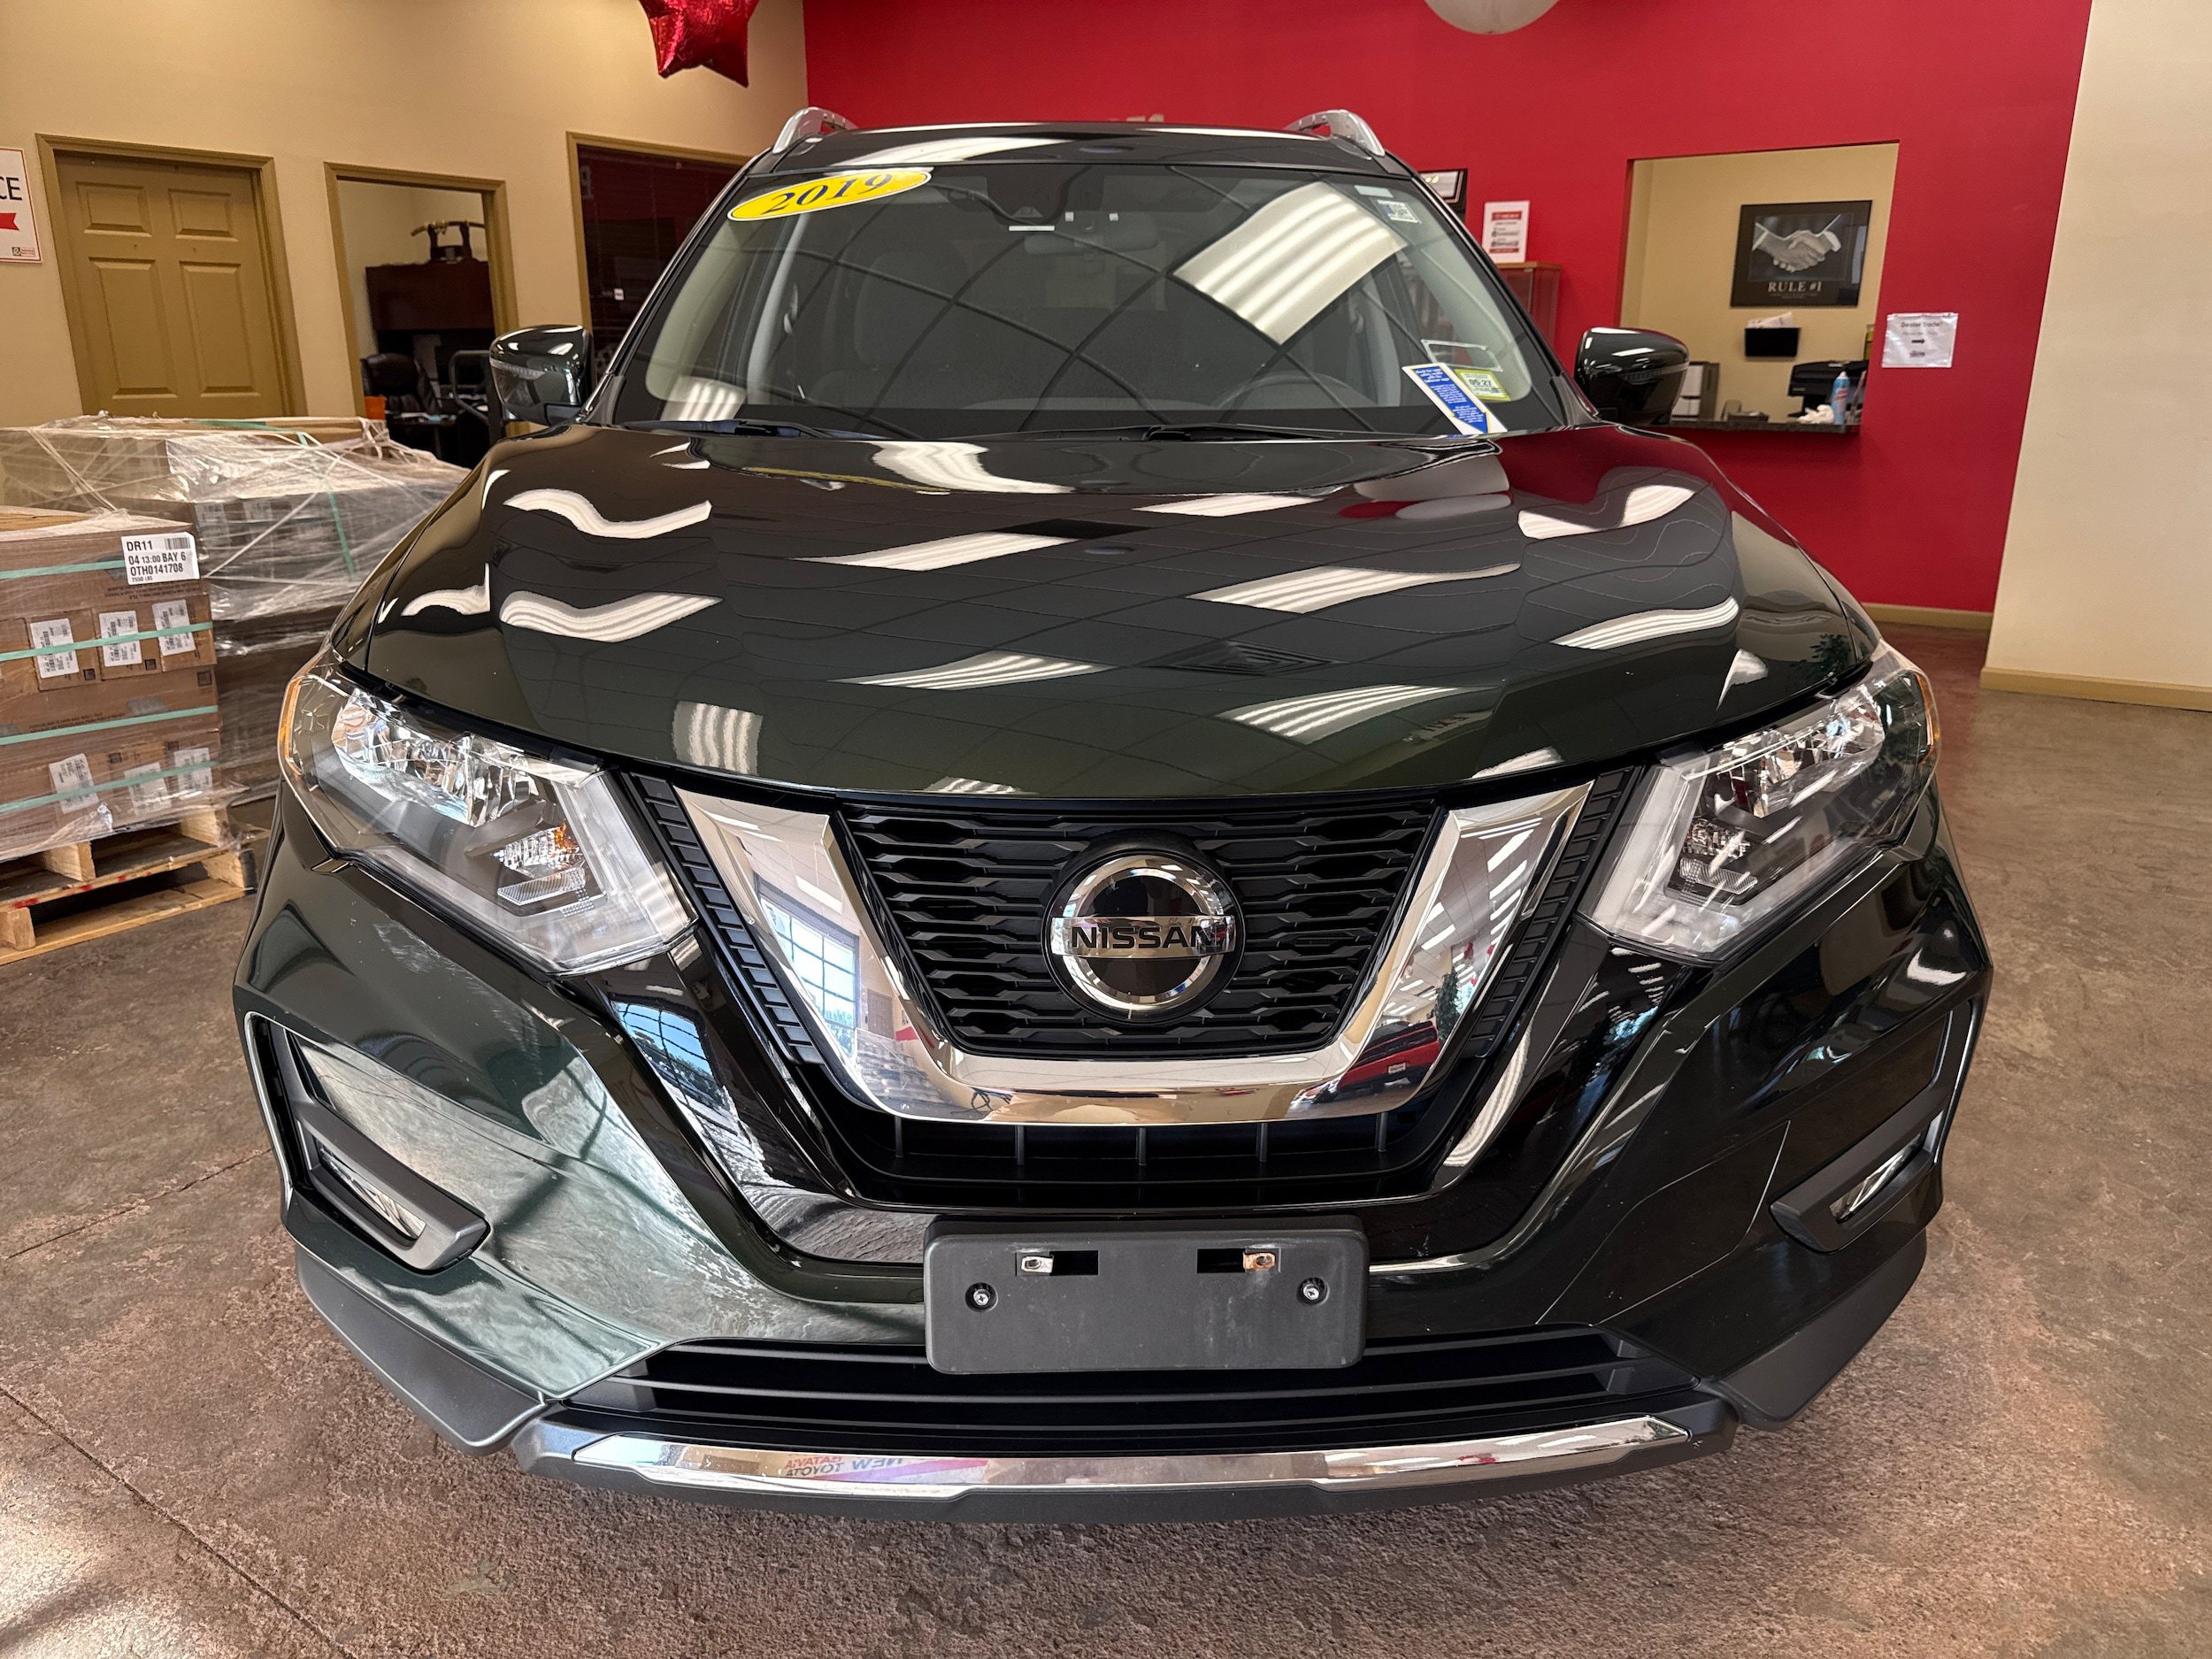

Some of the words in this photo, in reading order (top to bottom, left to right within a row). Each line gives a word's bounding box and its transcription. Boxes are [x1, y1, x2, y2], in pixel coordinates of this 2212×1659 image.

[760, 173, 892, 215] 2019
[1768, 281, 1807, 292] RULE
[1809, 281, 1822, 292] #1
[126, 541, 153, 552] DR11
[128, 555, 140, 565] 04
[162, 552, 178, 563] BAY
[180, 551, 187, 562] 6
[1071, 926, 1215, 949] NISSAN
